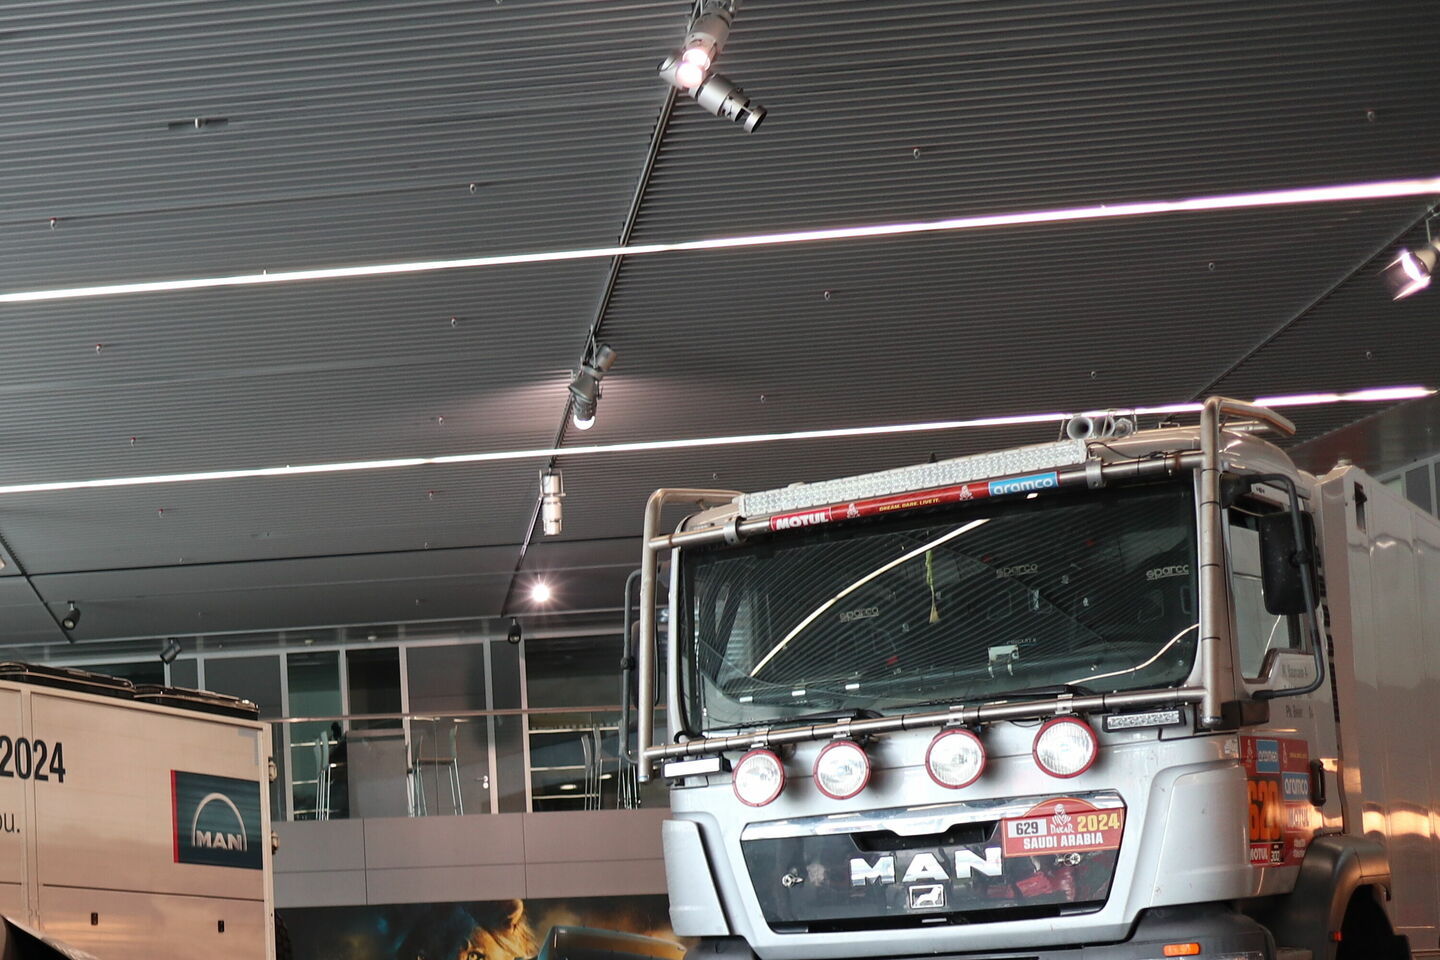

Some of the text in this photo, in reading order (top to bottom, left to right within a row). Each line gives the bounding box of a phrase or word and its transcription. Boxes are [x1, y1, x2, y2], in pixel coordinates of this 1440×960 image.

[993, 478, 1054, 496] aramco
[776, 512, 829, 530] MOTUL
[1015, 821, 1039, 836] 629
[1077, 812, 1120, 833] 2024
[195, 829, 243, 851] MAN
[1023, 831, 1104, 850] SAUDI ARABIA
[850, 846, 1003, 888] MAN
